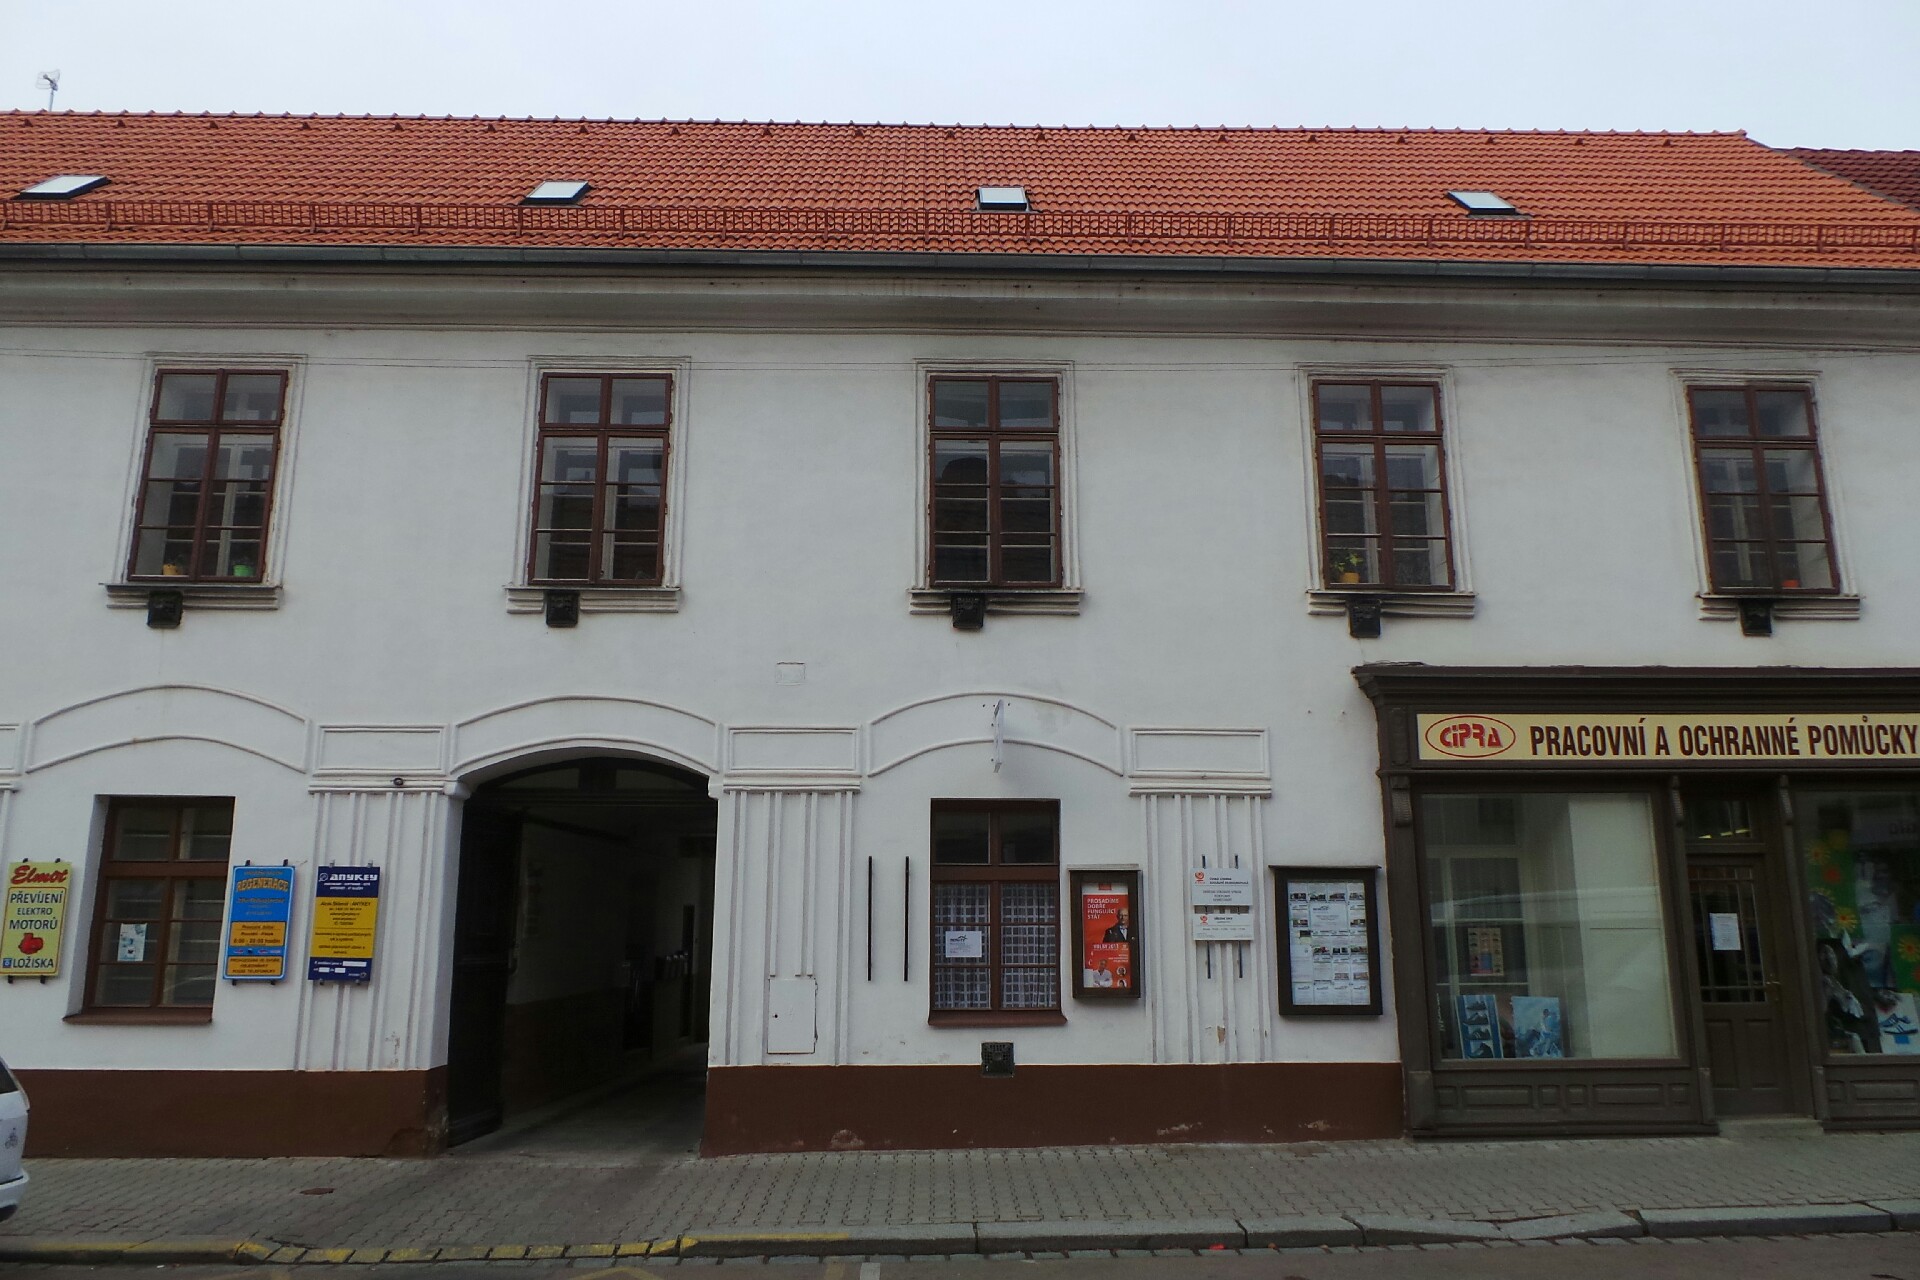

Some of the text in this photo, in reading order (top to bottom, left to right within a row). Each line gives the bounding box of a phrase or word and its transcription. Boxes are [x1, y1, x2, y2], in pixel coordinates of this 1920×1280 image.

[1529, 715, 1918, 756] PRACOVNÍ A OCHRANNÉ POMŮCKY
[11, 865, 68, 884] Elmot
[237, 878, 288, 892] REGENERACE
[10, 891, 63, 904] PŘEVÍJENÍ
[17, 907, 53, 915] ELEKTRO
[9, 917, 58, 930] MOTORŮ
[13, 956, 54, 968] LOŽISKA
